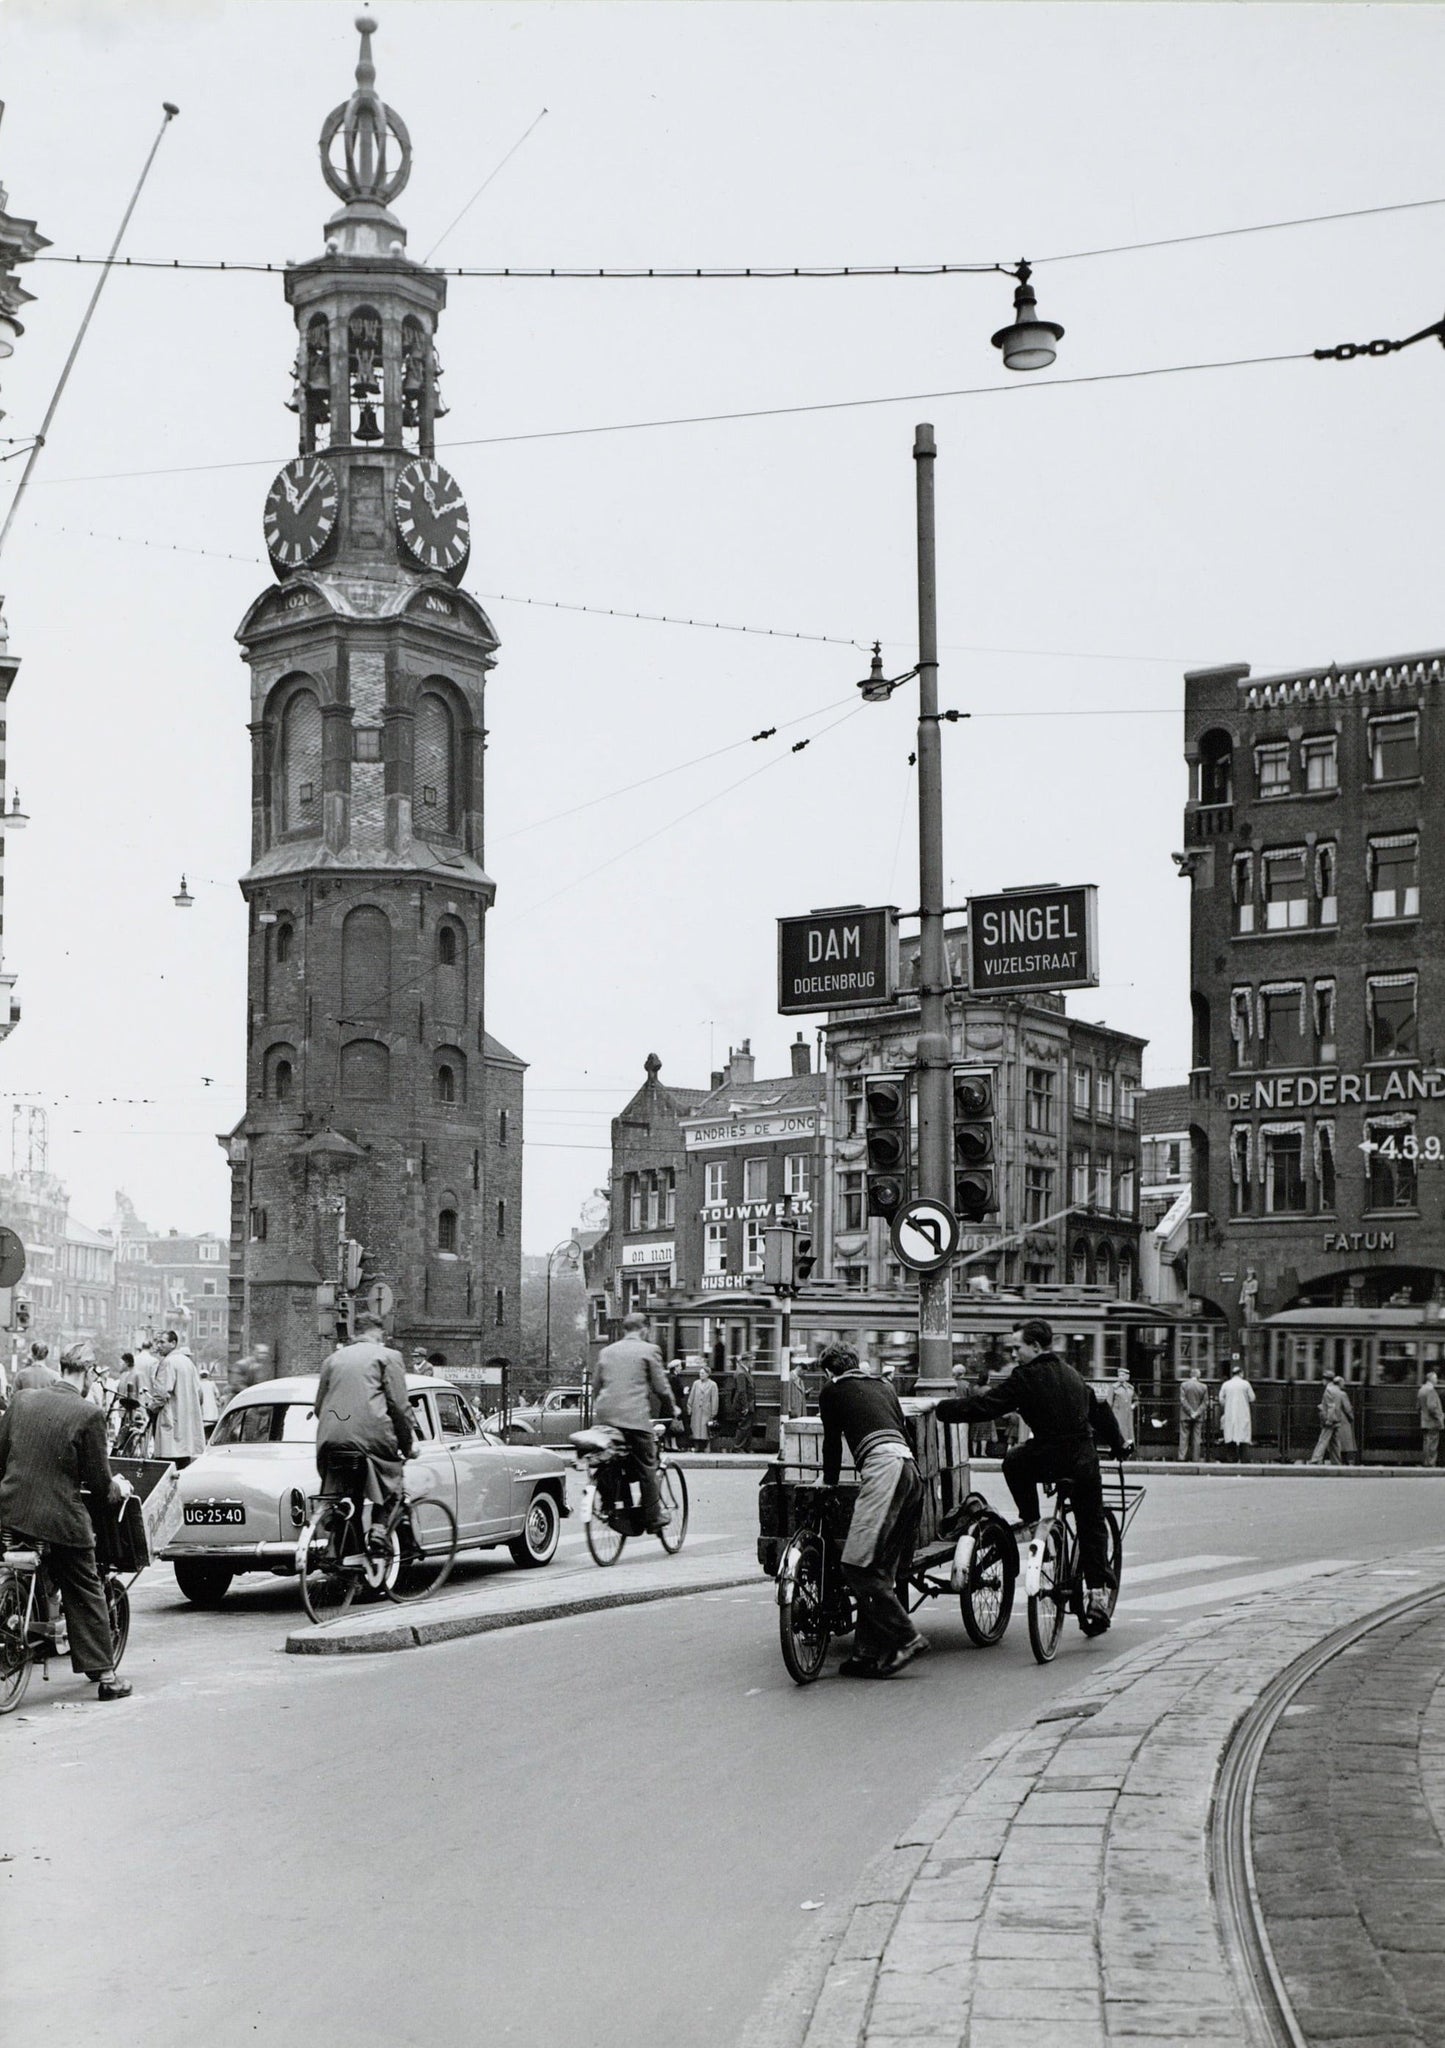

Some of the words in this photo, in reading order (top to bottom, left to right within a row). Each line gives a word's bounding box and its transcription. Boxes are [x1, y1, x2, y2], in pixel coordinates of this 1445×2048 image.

[982, 904, 1078, 946] SINGEL
[808, 925, 861, 963] DAM
[984, 951, 1078, 976] VIJZELSTRAAT
[794, 971, 875, 995] DOELENBRUG
[1227, 1092, 1252, 1111] DE
[694, 1123, 747, 1142] ANDRIES
[754, 1123, 770, 1135] DE
[780, 1116, 815, 1132] JONG
[700, 1200, 813, 1222] TOUWWERK
[1323, 1231, 1395, 1251] FATUM
